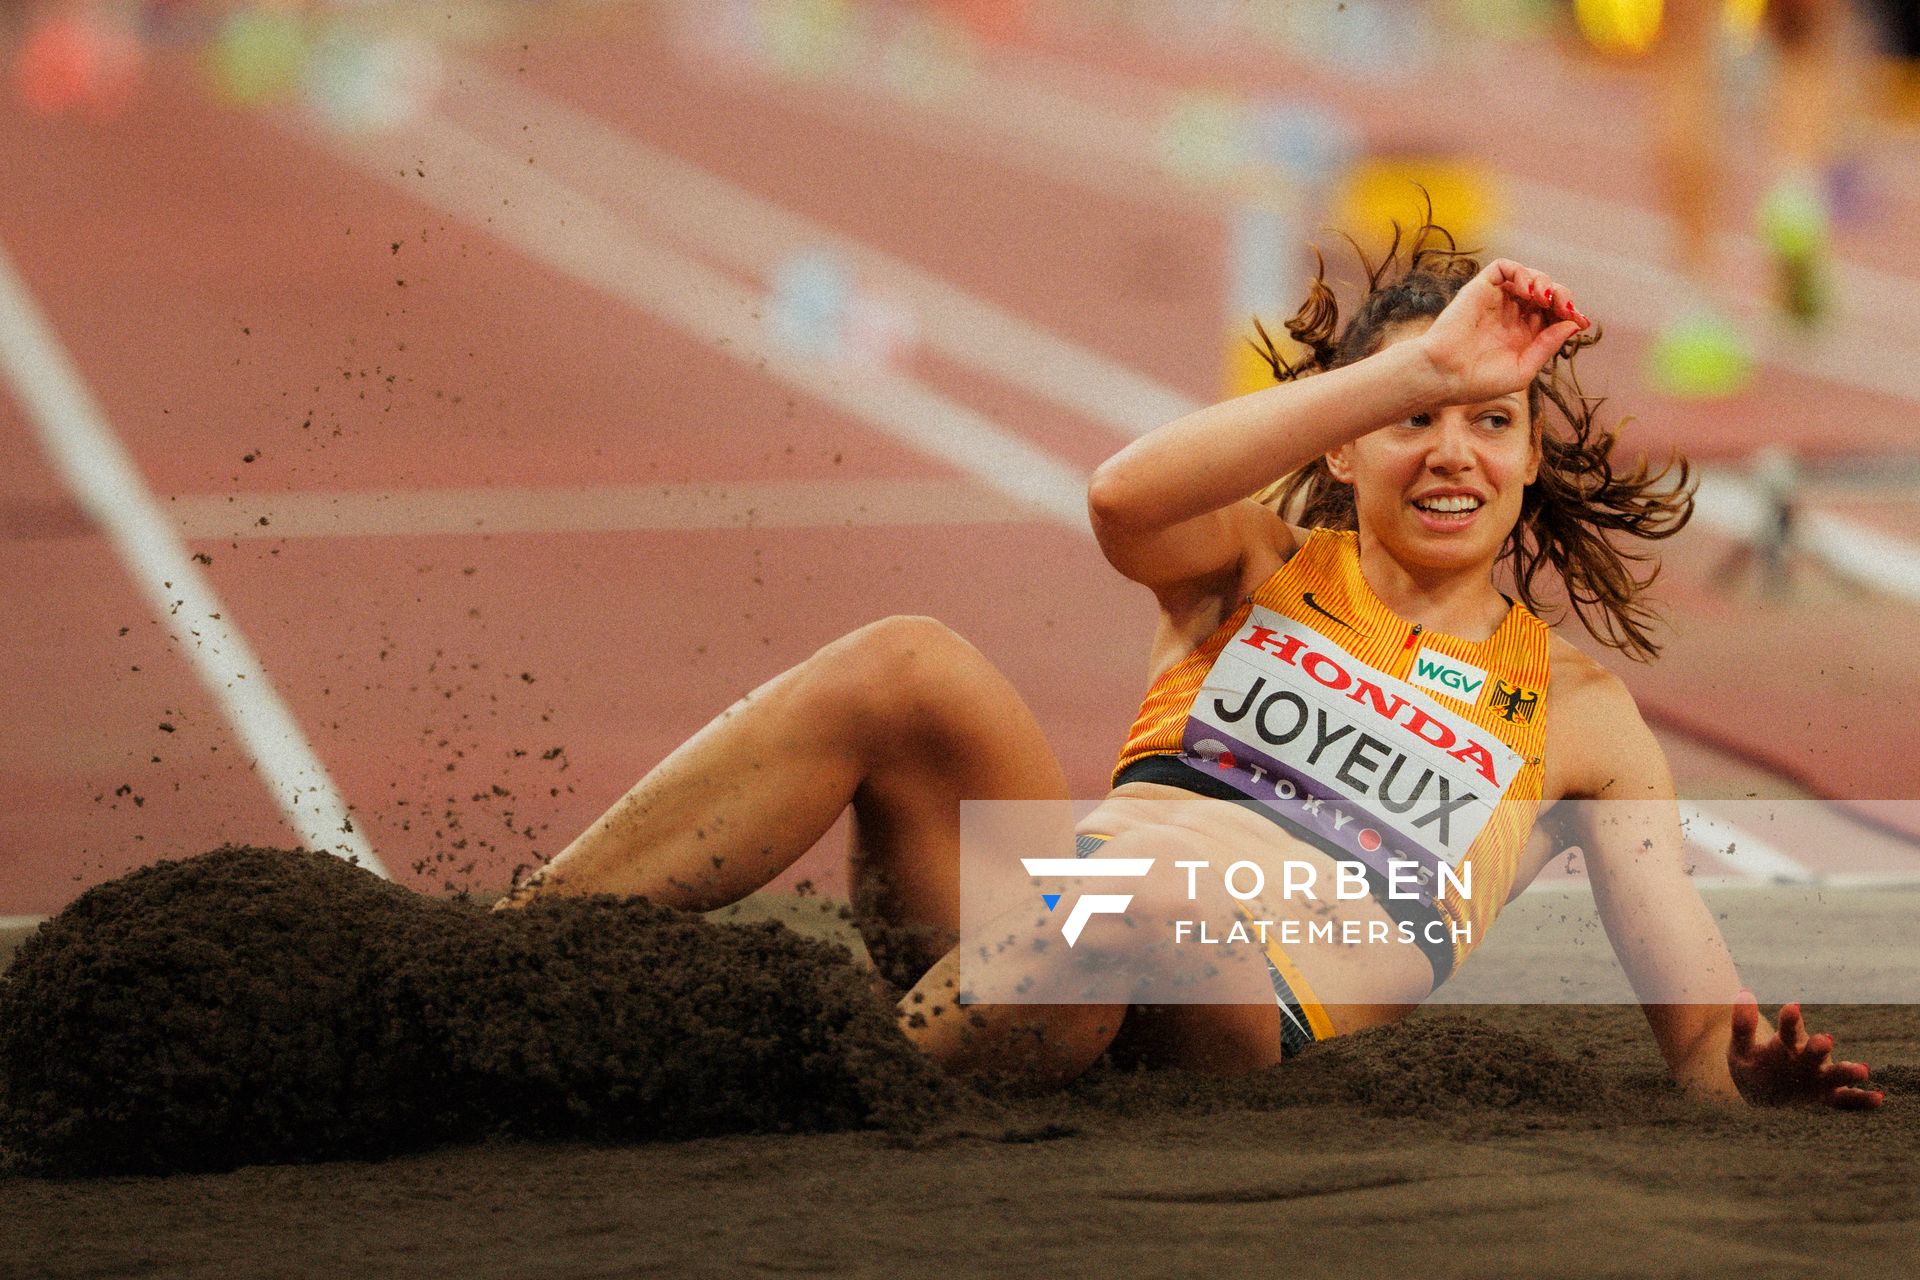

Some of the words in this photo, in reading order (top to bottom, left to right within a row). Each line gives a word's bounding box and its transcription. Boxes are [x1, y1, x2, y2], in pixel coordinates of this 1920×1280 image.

[1240, 625, 1501, 788] HONDA
[1417, 658, 1483, 693] WGV
[1213, 676, 1479, 847] JOYEUX
